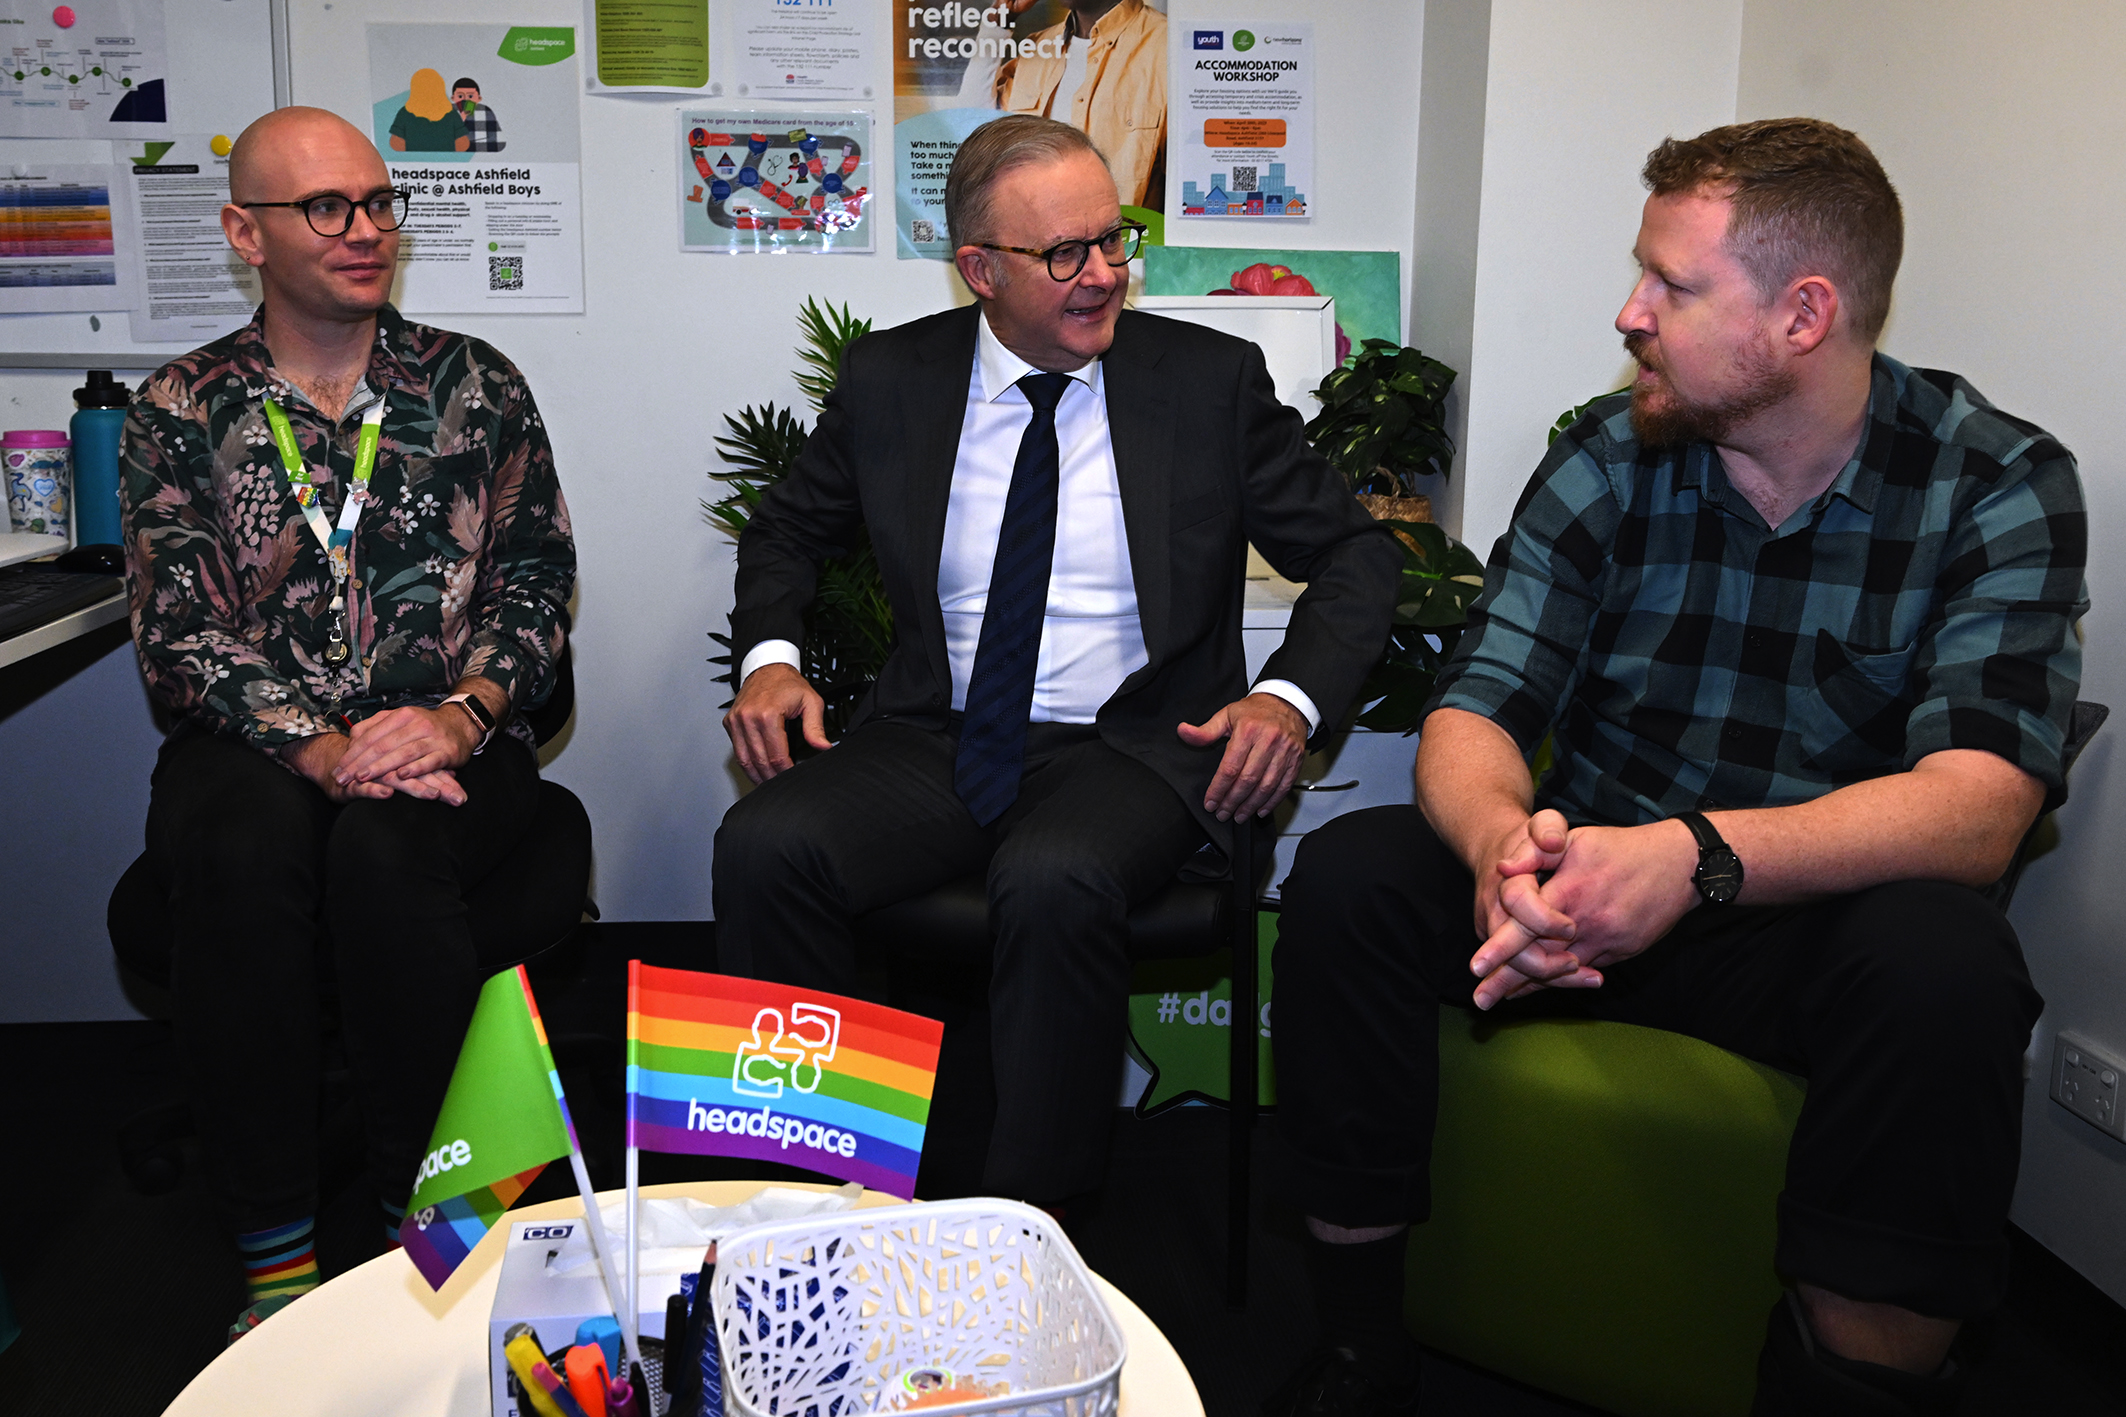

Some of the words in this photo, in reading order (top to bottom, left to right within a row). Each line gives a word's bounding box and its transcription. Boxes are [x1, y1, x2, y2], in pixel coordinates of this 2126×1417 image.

[908, 2, 1016, 28] reflect.
[908, 34, 1071, 59] reconnect.
[1195, 60, 1298, 71] ACCOMMODATION
[1213, 72, 1280, 81] WORKSHOP
[798, 118, 813, 126] from
[910, 141, 938, 149] When
[940, 141, 961, 149] thin
[910, 151, 926, 159] too
[911, 162, 934, 170] Take
[392, 168, 470, 182] headspace
[474, 168, 530, 180] Ashfield
[911, 172, 947, 180] somethi
[394, 183, 428, 195] clinic
[432, 184, 444, 197] @
[448, 183, 504, 195] Ashfield
[508, 184, 541, 197] Boys
[911, 187, 918, 195] It
[920, 187, 938, 195] can
[278, 425, 293, 457] headspace
[360, 436, 372, 469] headspace
[687, 1097, 857, 1158] headspace
